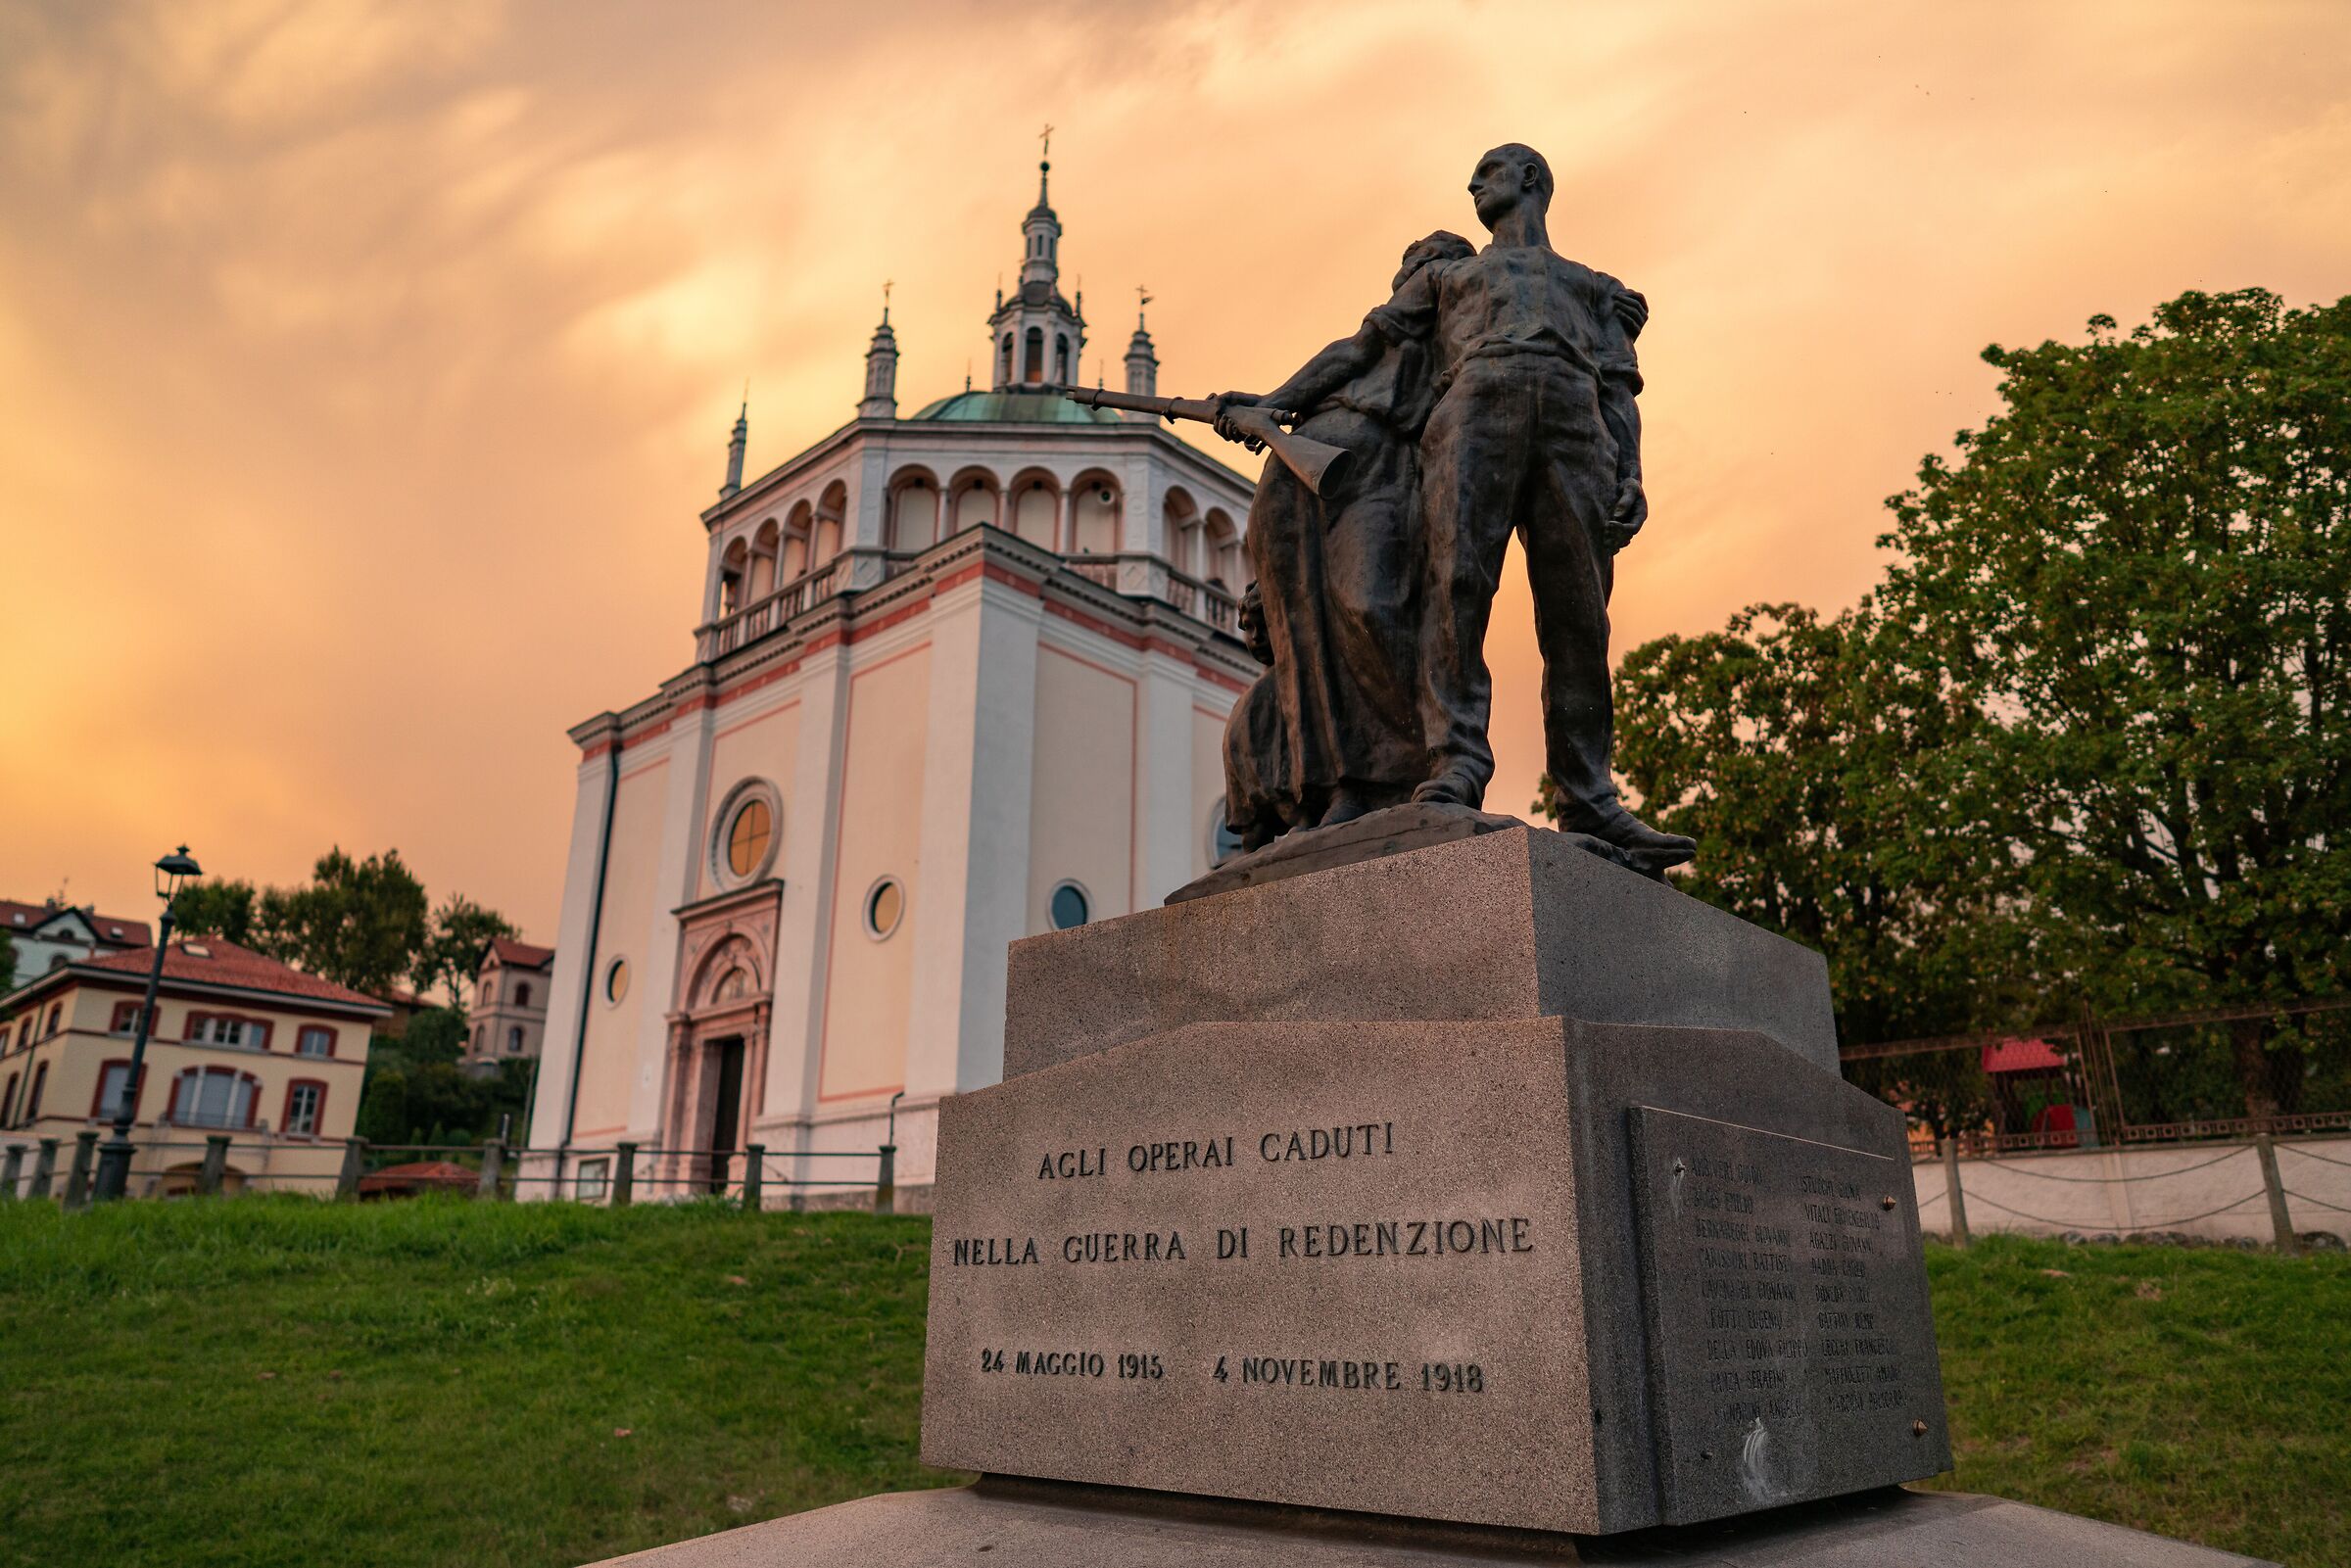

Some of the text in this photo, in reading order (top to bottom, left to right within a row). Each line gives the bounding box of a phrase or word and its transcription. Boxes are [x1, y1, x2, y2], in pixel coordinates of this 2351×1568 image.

[1037, 1122, 1393, 1180] AGLI OPERAI CADUTI
[1803, 1203, 1830, 1223] VITALI
[953, 1217, 1533, 1265] NELLA GUERRA DI REDENZIONE
[1809, 1231, 1837, 1252] AGAZZI
[1752, 1252, 1793, 1272] BATTIST
[981, 1349, 1483, 1393] 24 MAGGIO 1915 4 NOVEMBRE 1918
